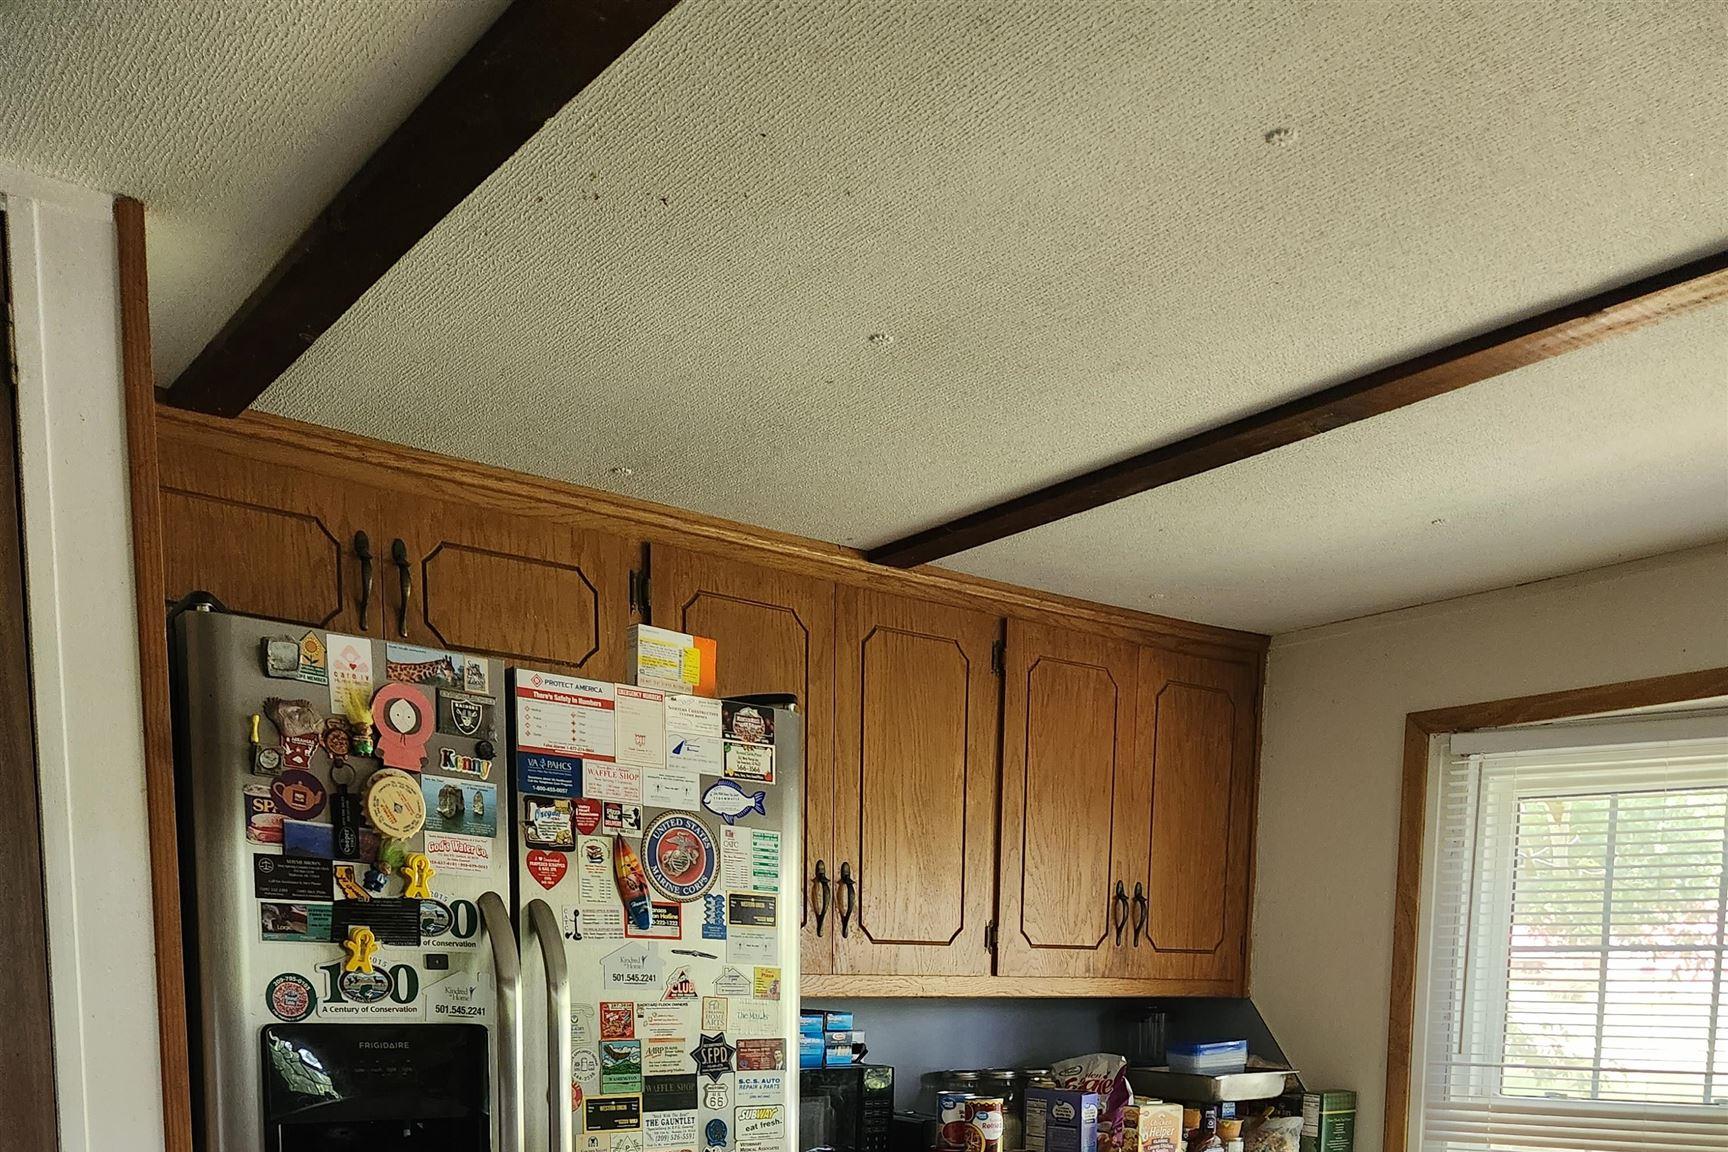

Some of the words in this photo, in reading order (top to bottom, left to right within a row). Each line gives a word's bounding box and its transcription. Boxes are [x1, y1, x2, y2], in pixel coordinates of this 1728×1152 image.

[307, 674, 326, 682] MEMBER
[544, 679, 573, 689] PROTECT
[575, 684, 603, 694] AMERICA
[533, 691, 553, 700] There's
[554, 694, 572, 703] Safety
[578, 697, 602, 707] Numbers
[441, 748, 492, 780] Kenny
[528, 758, 539, 767] VA
[547, 760, 572, 770] PAHCS
[587, 768, 618, 779] WAFFLE
[619, 770, 640, 781] SHOP
[253, 798, 278, 813] SP
[652, 818, 683, 840] UNITED
[685, 819, 711, 849] STATES
[428, 840, 450, 854] God's
[451, 840, 475, 855] Water
[476, 845, 489, 859] Co.
[650, 865, 680, 894] MARINE
[683, 875, 709, 895] CORPS
[432, 940, 477, 948] Conservation
[612, 973, 657, 982] 501.545.2241
[445, 986, 468, 996] Kindred
[671, 982, 695, 993] CLUB
[330, 1006, 359, 1015] Century
[435, 1004, 486, 1016] 501.545.2241
[359, 1041, 410, 1049] FRIGIDAIRE
[646, 1046, 665, 1056] AARP
[645, 1083, 675, 1093] WAFFLE
[677, 1082, 695, 1092] SHOP
[709, 1096, 724, 1107] 66
[739, 1107, 778, 1121] SUBWAY
[646, 1119, 659, 1128] THE
[661, 1116, 695, 1127] GAUNTLET
[745, 1123, 759, 1132] eat
[760, 1118, 783, 1128] fresh.
[655, 1133, 669, 1142] (209)
[1150, 1127, 1175, 1139] Helper
